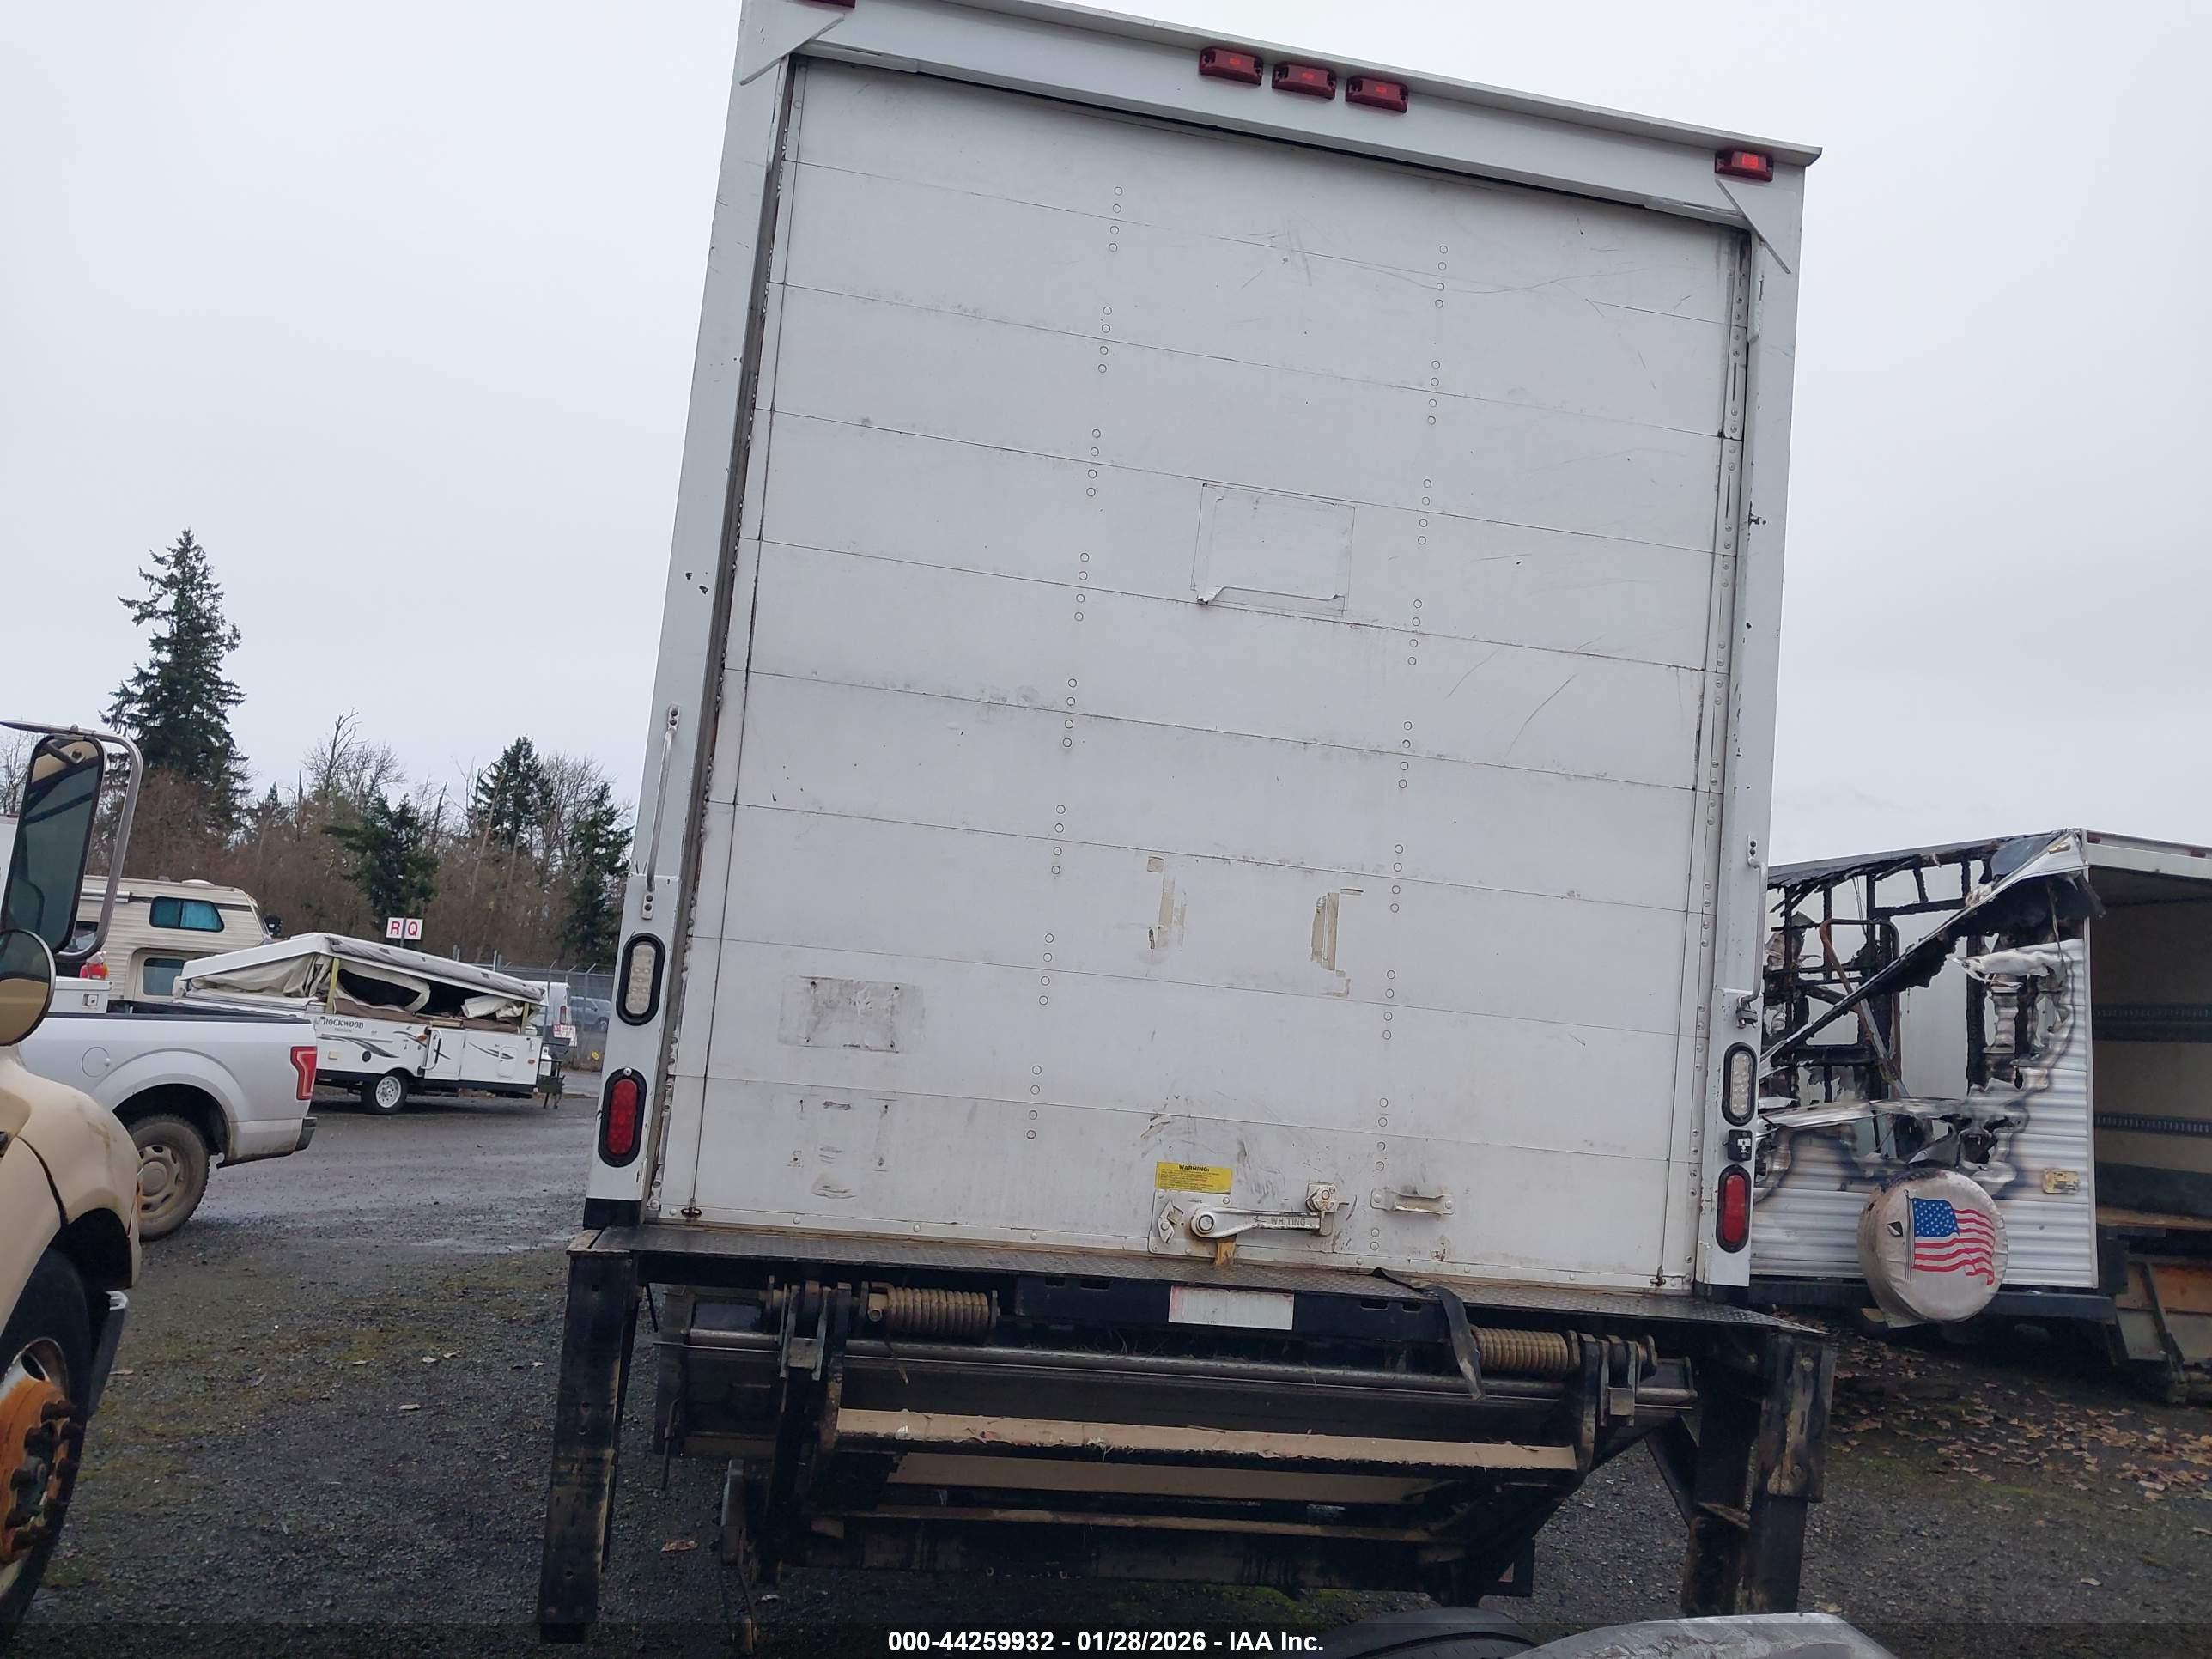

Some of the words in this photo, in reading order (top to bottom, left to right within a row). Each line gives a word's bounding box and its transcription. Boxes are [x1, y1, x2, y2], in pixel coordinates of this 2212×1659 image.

[391, 921, 400, 935] R
[408, 921, 418, 937] Q
[320, 1017, 364, 1029] ROCKWOOD
[1271, 1218, 1306, 1226] WHITING
